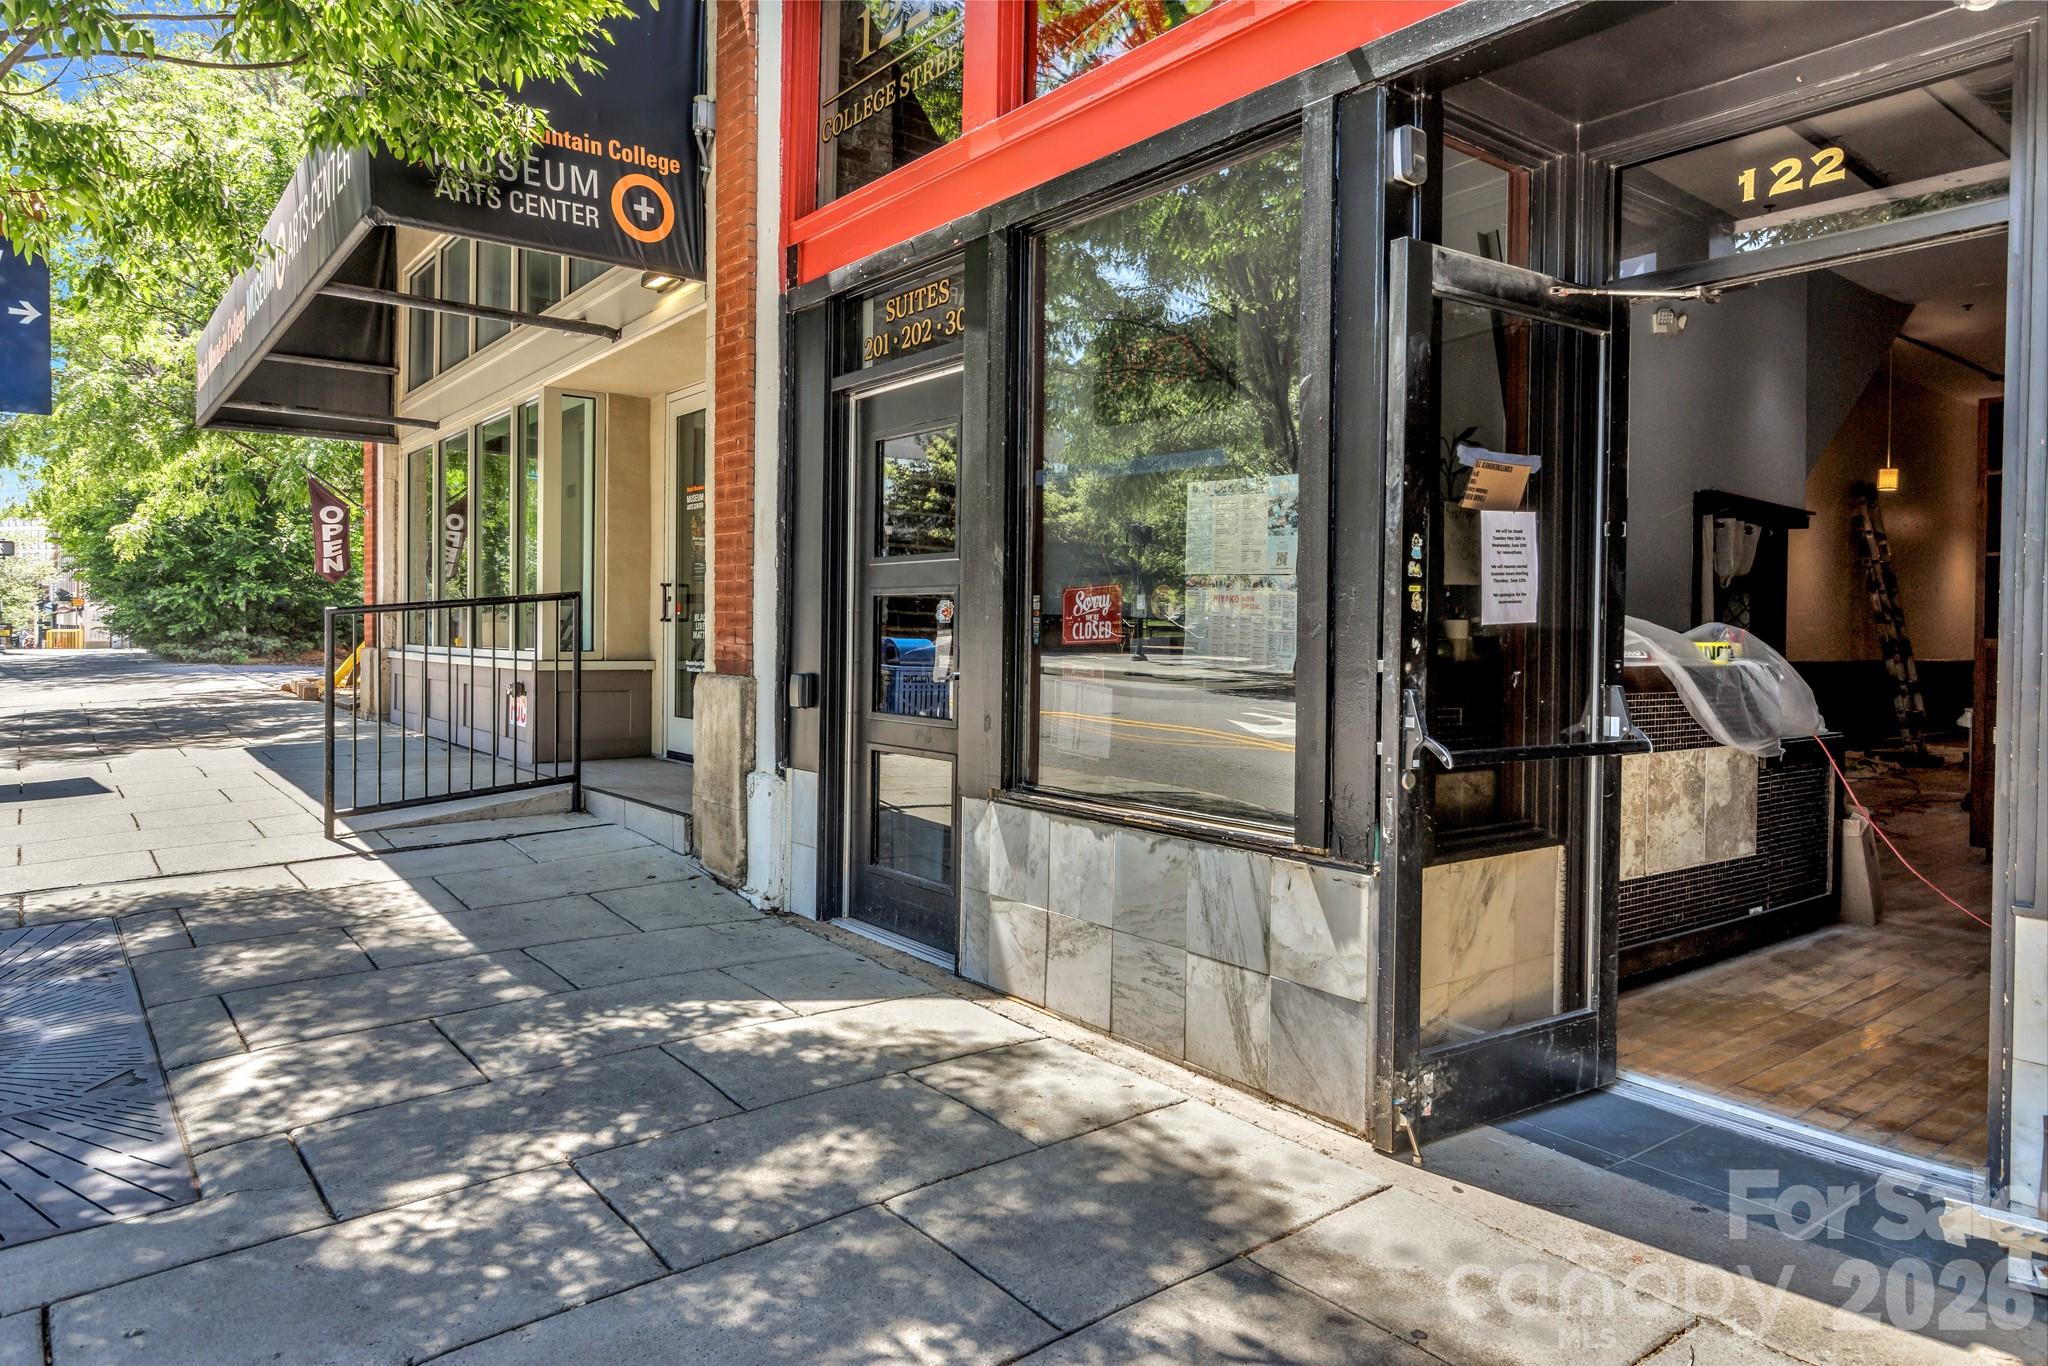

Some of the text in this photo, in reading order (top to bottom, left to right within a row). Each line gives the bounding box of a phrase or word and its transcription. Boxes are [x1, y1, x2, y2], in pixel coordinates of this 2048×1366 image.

[856, 0, 930, 64] 12
[822, 40, 964, 143] COLLEGE STREE
[527, 127, 681, 174] untain College
[1738, 147, 1846, 202] 122
[287, 193, 308, 266] ARTS
[311, 142, 351, 231] CENTER
[435, 172, 600, 229] ARTS CENTER
[885, 278, 950, 322] SUITES
[864, 306, 965, 361] 201 202 30
[319, 505, 344, 574] OPEN
[1072, 620, 1112, 639] CLOSED
[1073, 590, 1112, 616] Sorry
